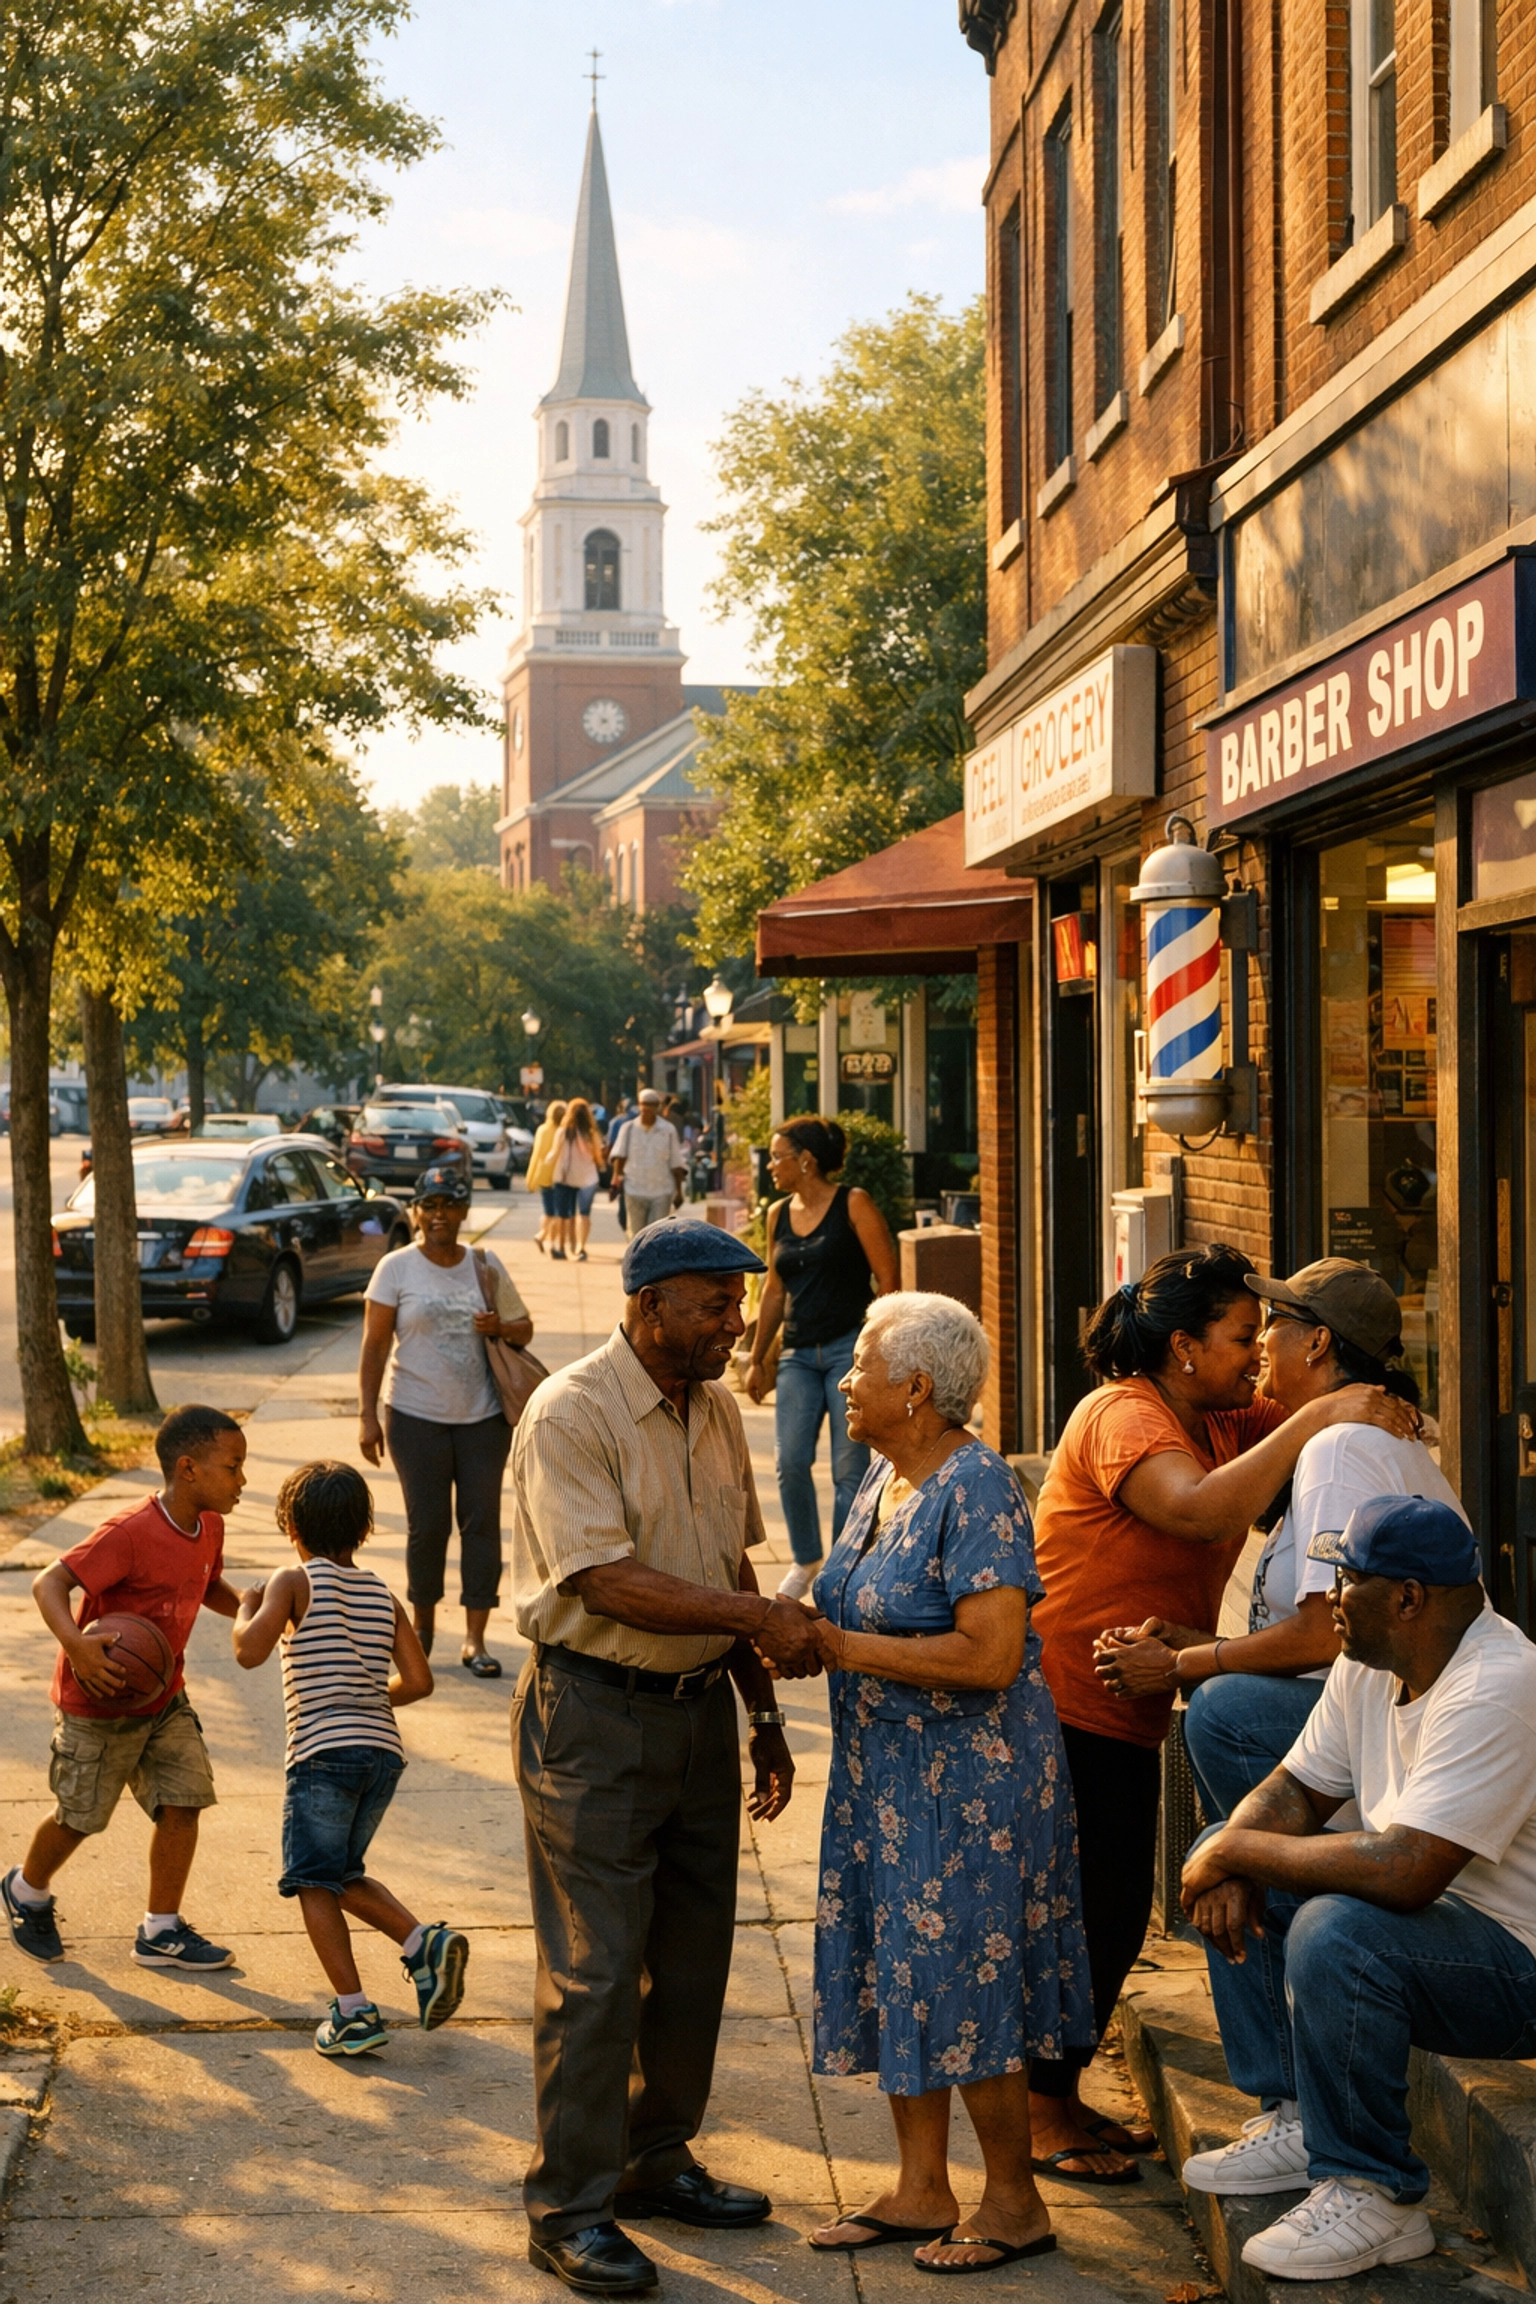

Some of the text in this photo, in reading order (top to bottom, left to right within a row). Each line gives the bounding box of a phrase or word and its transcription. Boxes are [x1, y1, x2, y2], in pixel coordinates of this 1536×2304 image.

[1021, 672, 1109, 793] GROCERY
[1221, 671, 1353, 806] BARBER
[1367, 600, 1484, 738] SHOP
